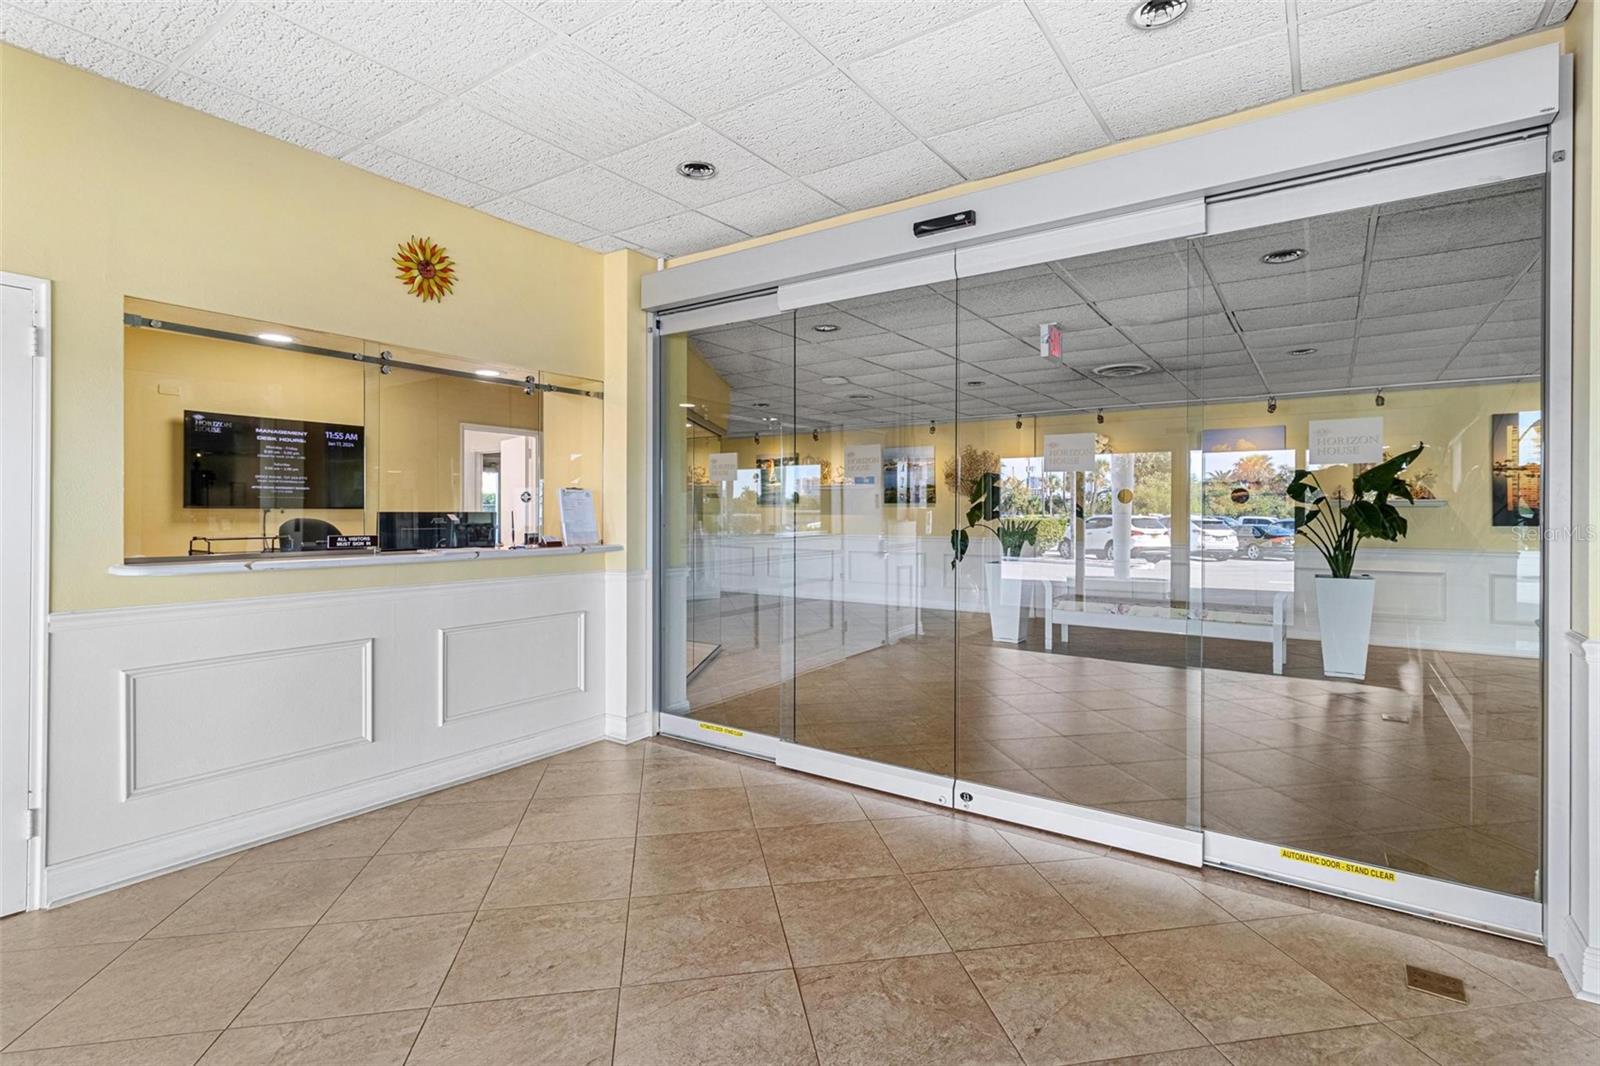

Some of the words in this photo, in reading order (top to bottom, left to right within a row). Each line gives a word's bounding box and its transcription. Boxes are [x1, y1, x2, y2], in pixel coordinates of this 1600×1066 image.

[255, 427, 308, 437] MANAGEMENT
[325, 431, 344, 440] 11:55
[345, 433, 359, 441] AM
[1317, 434, 1379, 447] HORIZON
[1317, 446, 1360, 457] HOUSE
[1282, 849, 1320, 865] AUTOMATIC
[1321, 859, 1341, 870] DOOR
[1346, 864, 1369, 876] STAND
[1370, 869, 1395, 881] CLEAR
